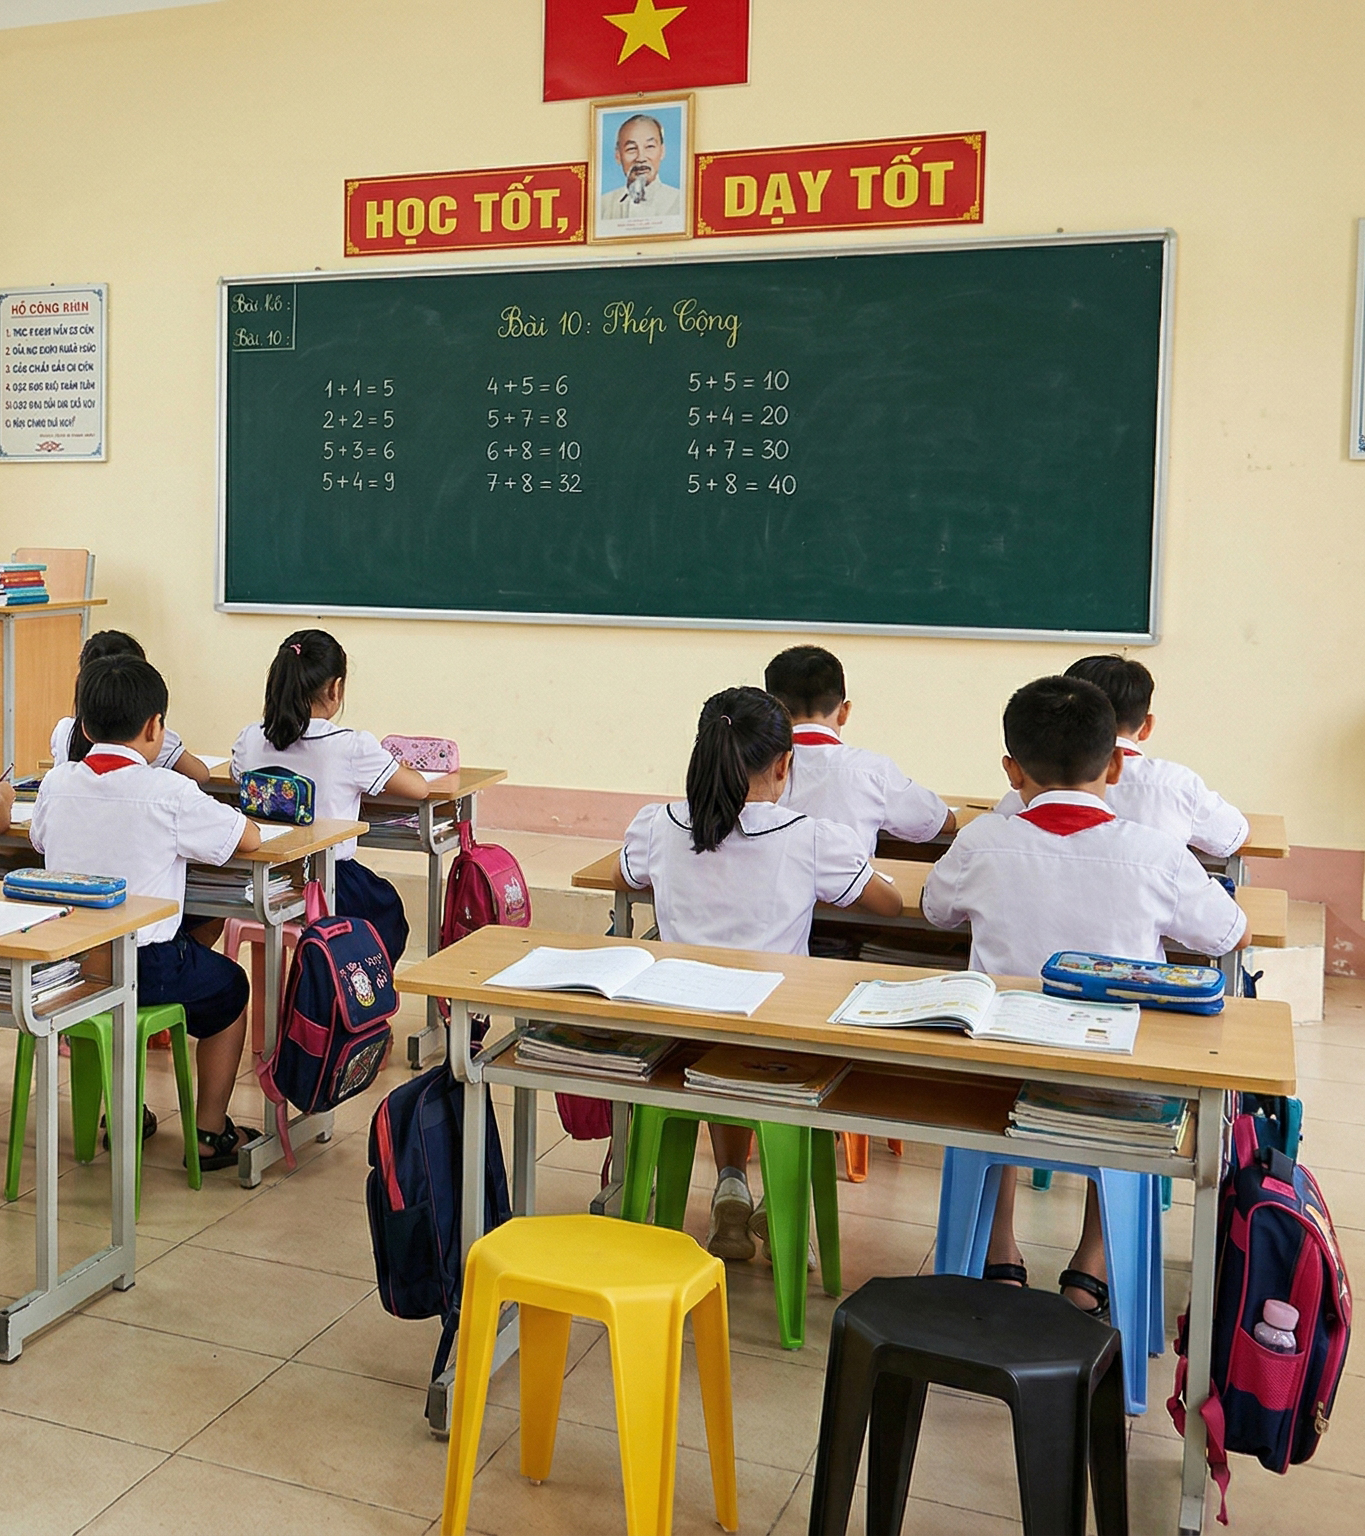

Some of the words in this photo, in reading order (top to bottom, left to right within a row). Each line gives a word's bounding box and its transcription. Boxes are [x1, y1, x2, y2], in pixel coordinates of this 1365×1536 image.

[365, 195, 458, 245] HỌC
[473, 175, 569, 234] TỐT,
[724, 169, 833, 225] DẠY
[849, 146, 954, 210] TỐT
[497, 304, 549, 338] Bài
[602, 300, 667, 344] Phép
[673, 298, 742, 348] Cộng
